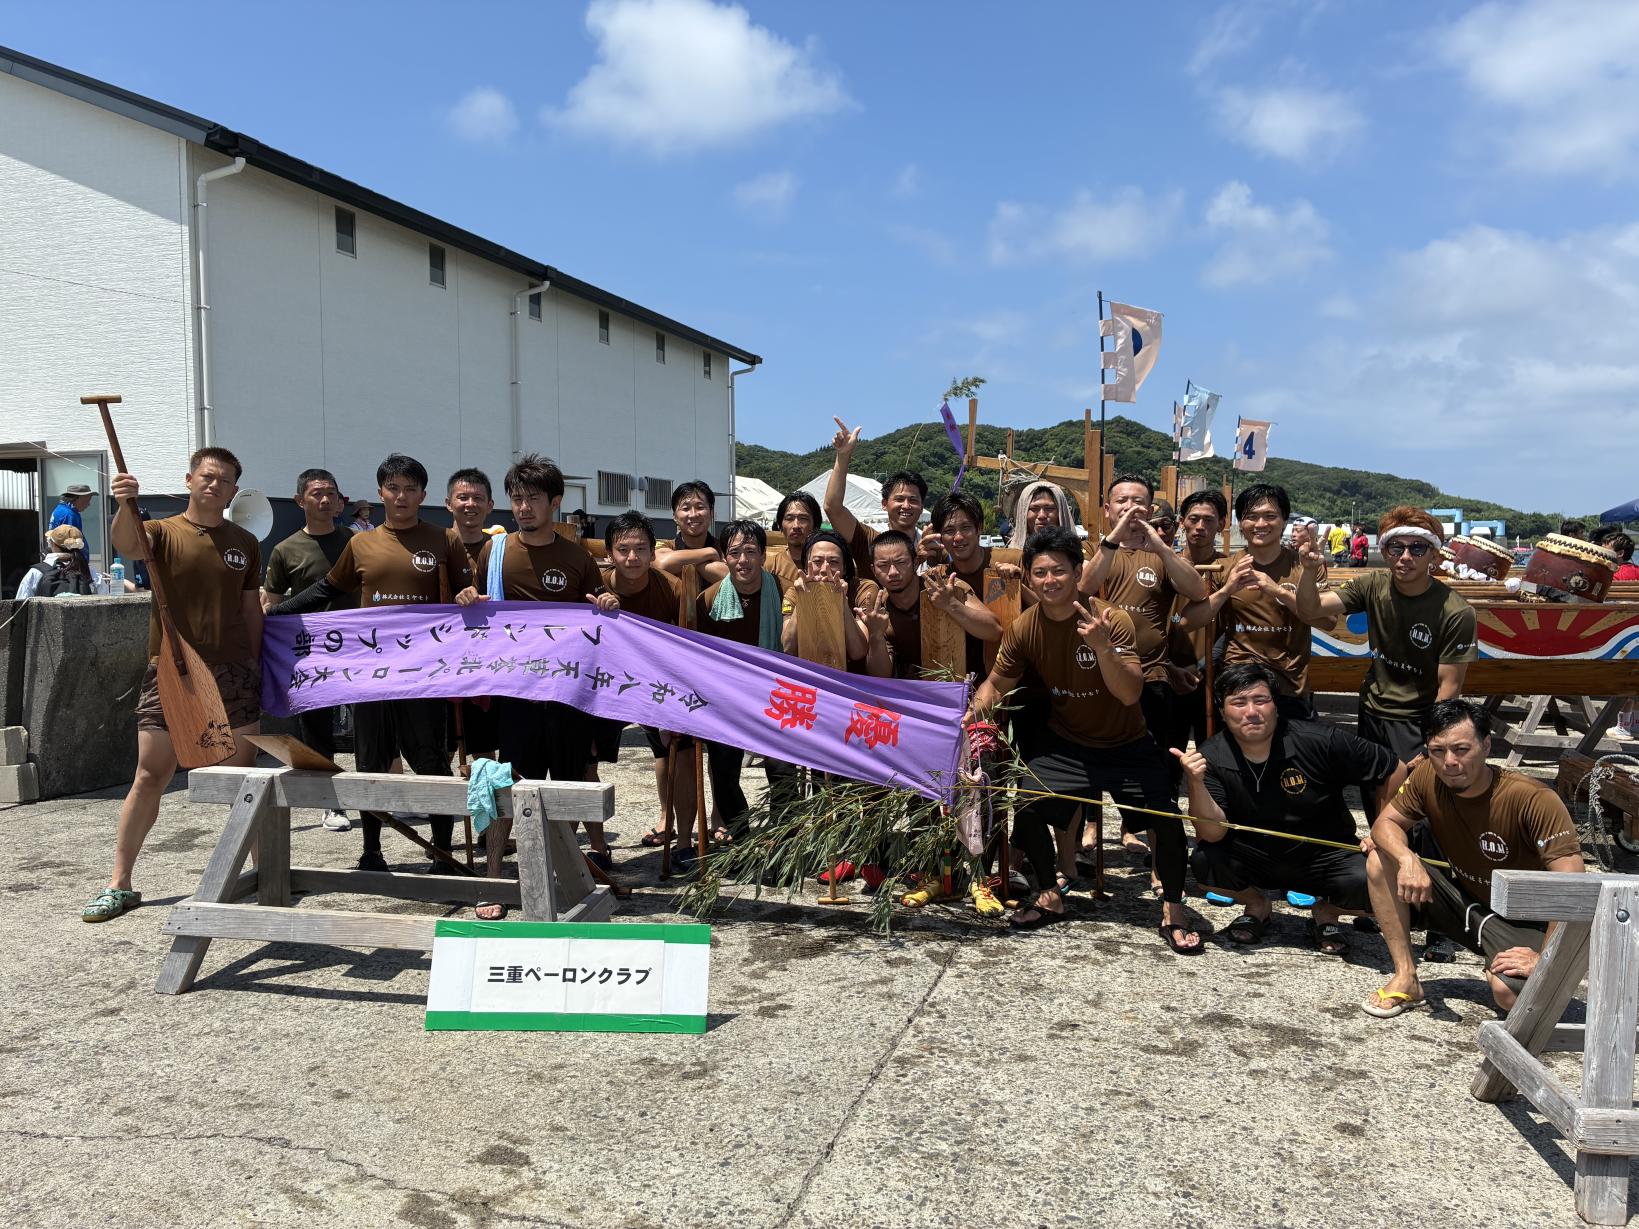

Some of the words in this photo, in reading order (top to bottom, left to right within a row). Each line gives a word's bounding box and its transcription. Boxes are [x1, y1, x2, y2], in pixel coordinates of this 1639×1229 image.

[1243, 431, 1255, 459] 4
[290, 623, 603, 656] フレンドシップの部
[289, 656, 709, 713] 令和八年天草苓北ペーロン大会
[763, 678, 902, 750] 優勝
[487, 965, 652, 986] 三重ペーロンクラブ
